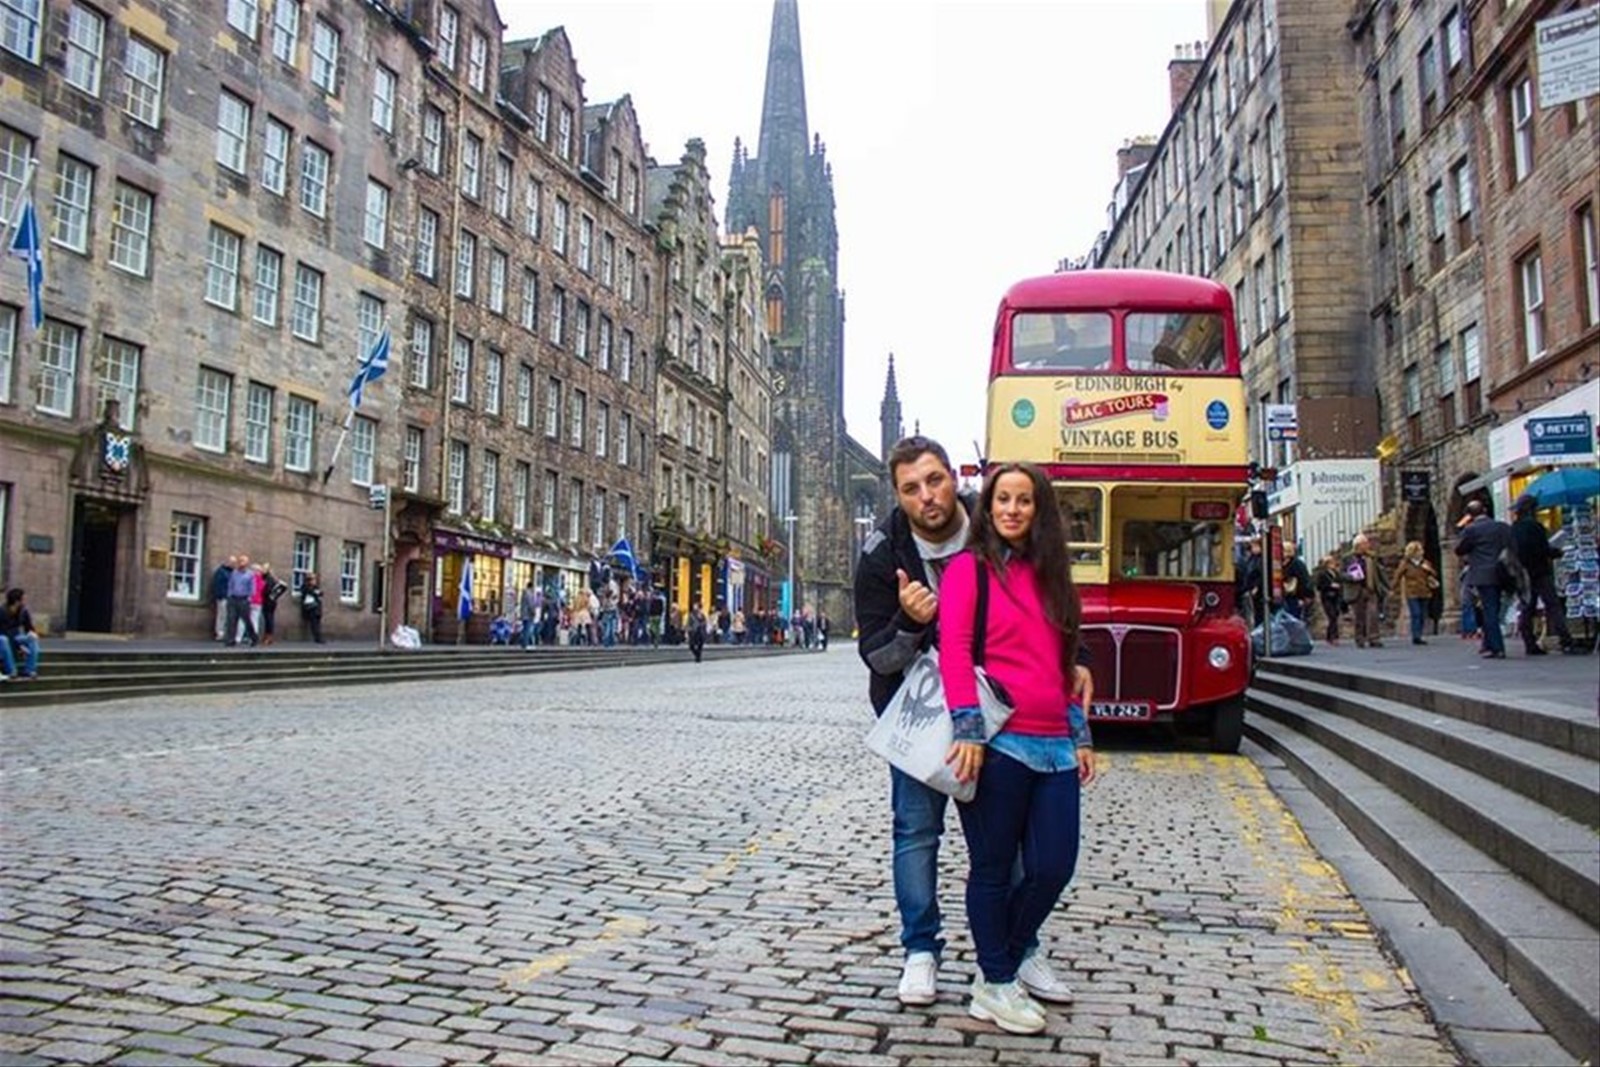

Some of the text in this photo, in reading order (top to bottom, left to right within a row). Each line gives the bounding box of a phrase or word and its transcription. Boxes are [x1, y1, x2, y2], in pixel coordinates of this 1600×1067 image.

[1075, 377, 1167, 391] EDINBURGH
[1070, 395, 1155, 420] MAC TOURS
[1060, 430, 1179, 448] VINTAGE BUS
[1311, 471, 1366, 486] Johnstons
[1118, 704, 1140, 717] 242
